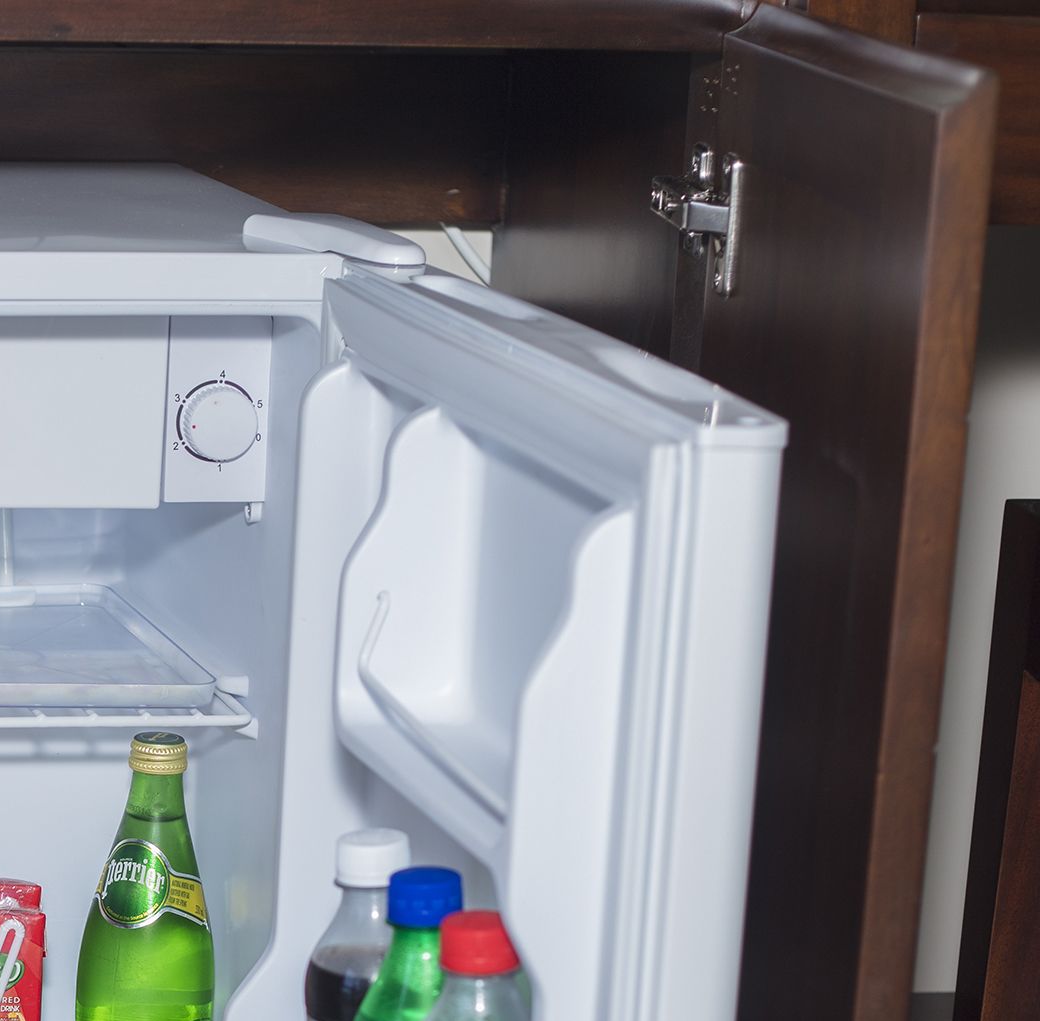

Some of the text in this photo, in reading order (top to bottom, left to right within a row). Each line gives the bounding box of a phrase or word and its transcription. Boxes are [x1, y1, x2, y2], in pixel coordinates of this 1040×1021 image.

[219, 369, 226, 379] 4
[174, 393, 181, 402] 3
[256, 399, 263, 409] 5
[255, 433, 262, 441] 0
[172, 442, 179, 451] 2
[217, 463, 222, 472] 1
